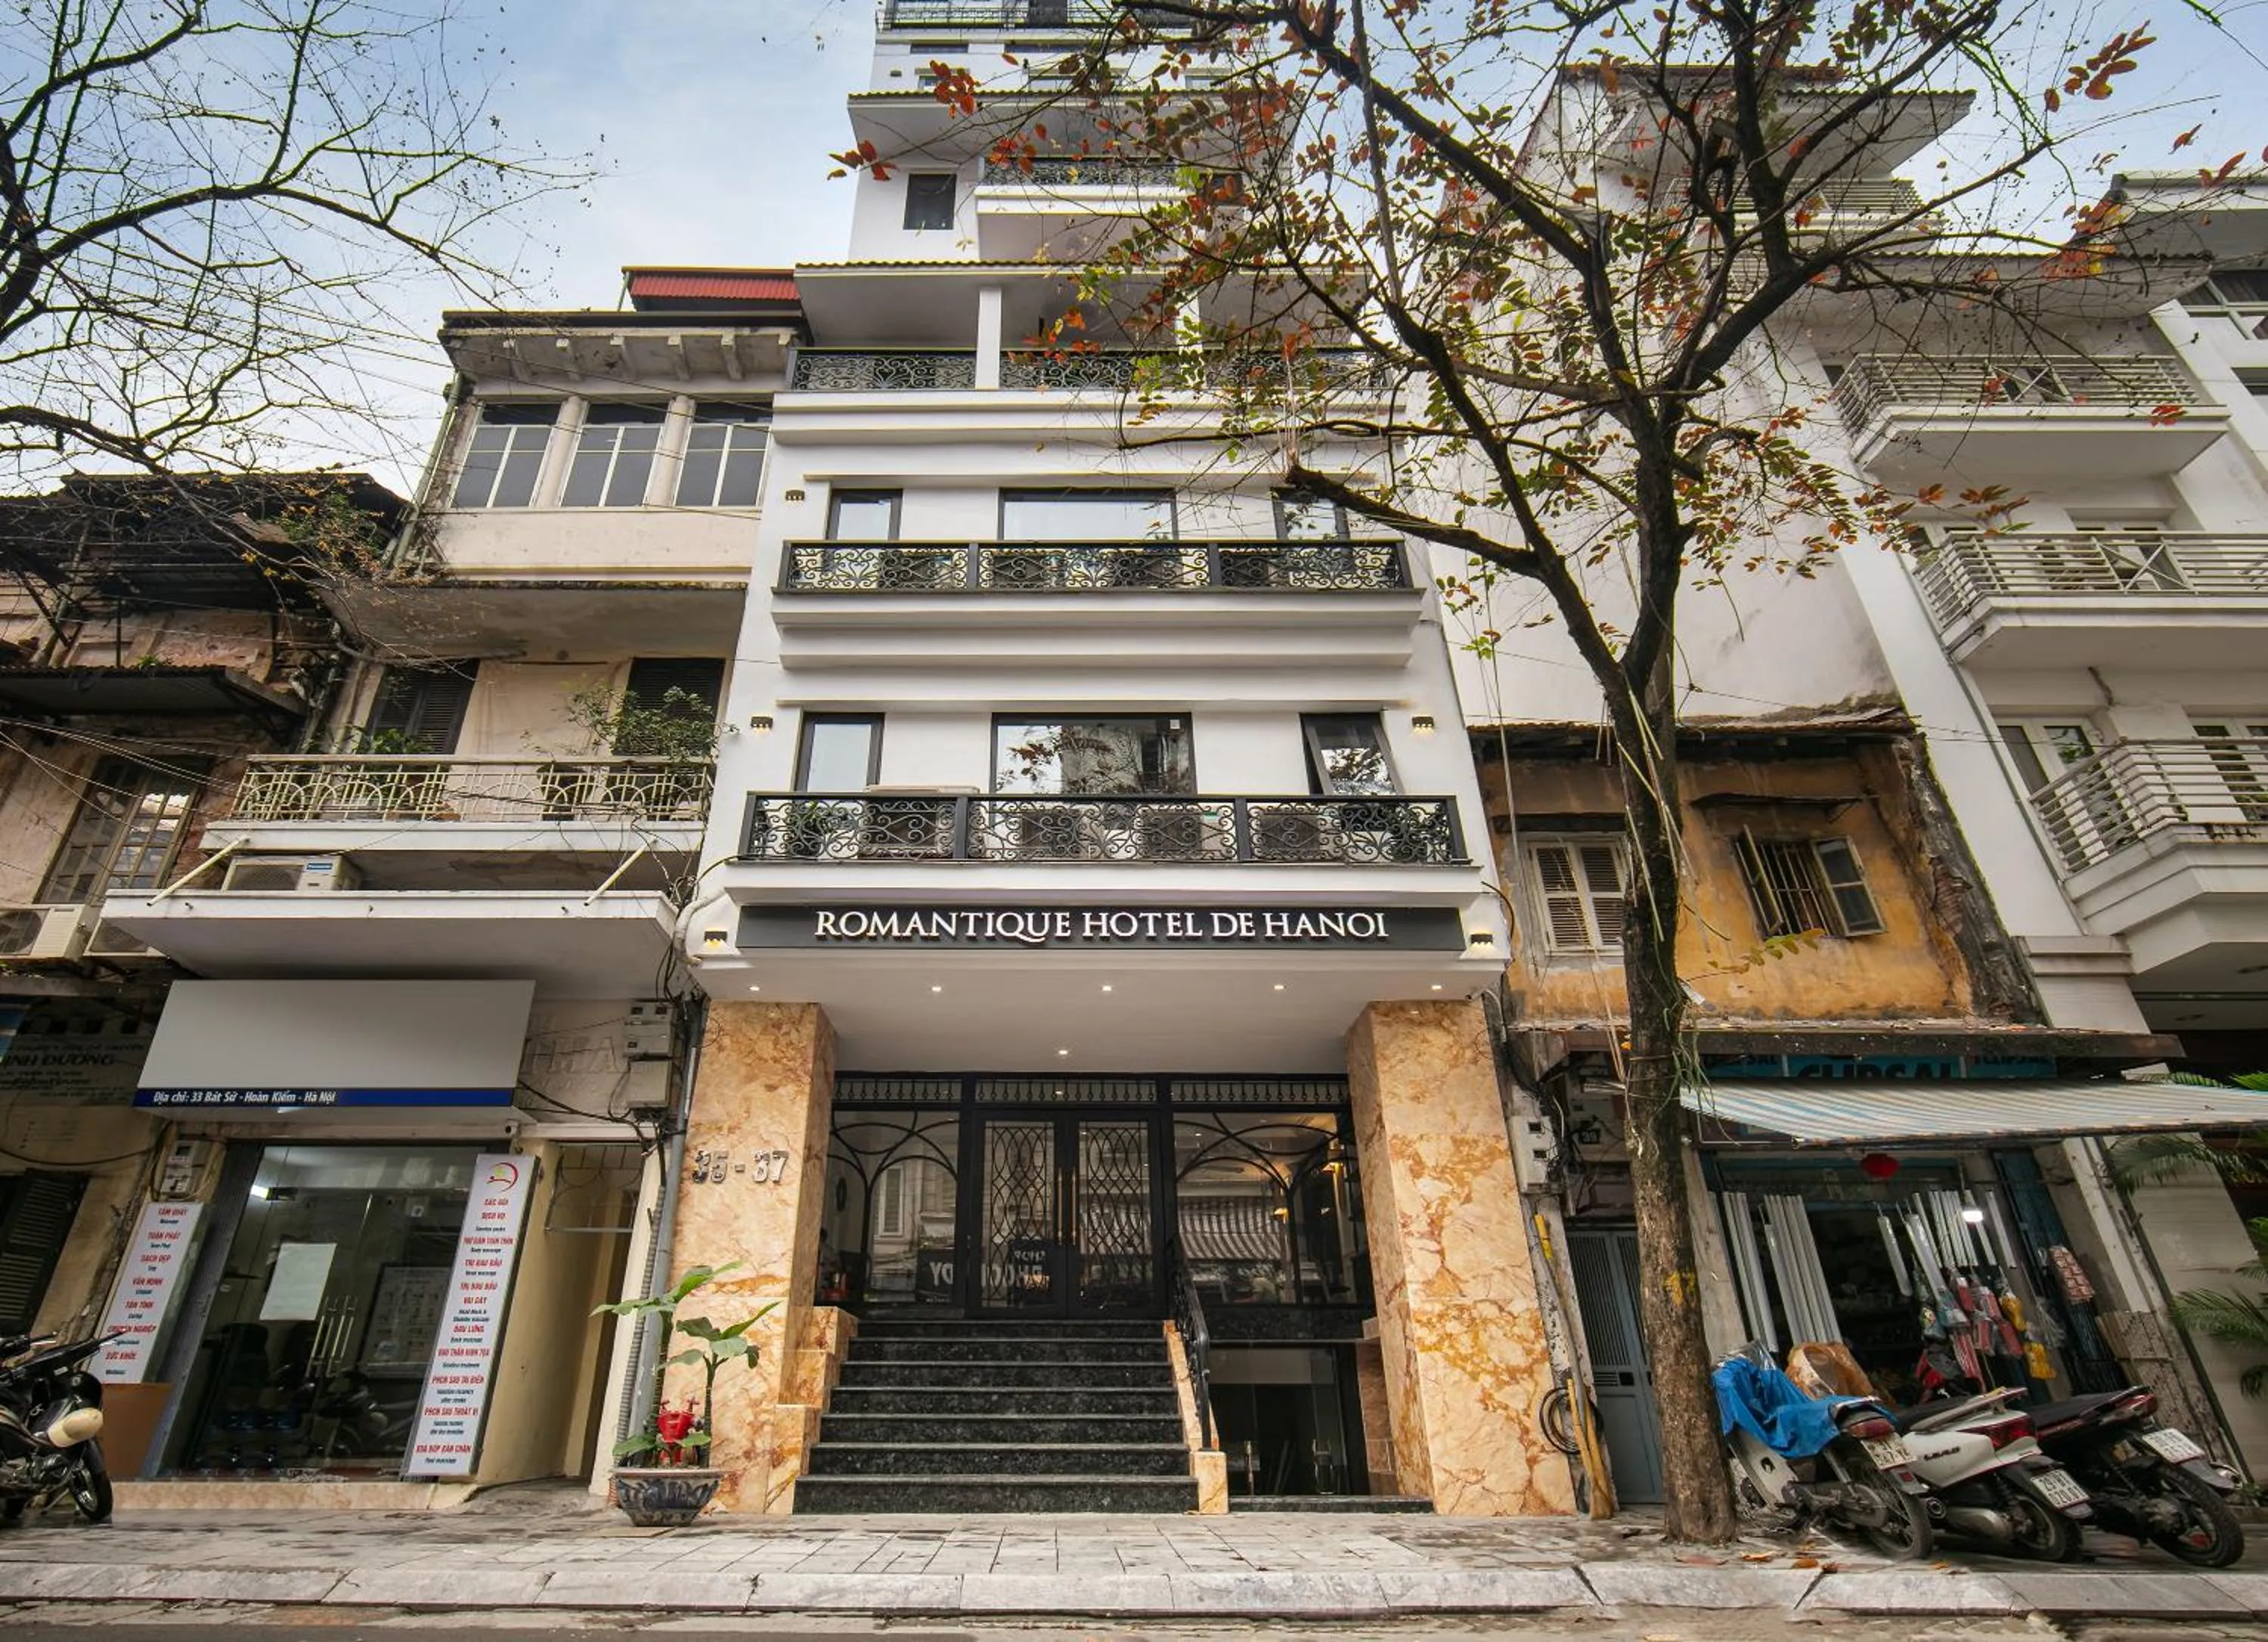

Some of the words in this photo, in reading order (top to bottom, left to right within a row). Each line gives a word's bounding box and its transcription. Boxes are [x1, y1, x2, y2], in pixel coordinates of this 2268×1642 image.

[814, 911, 1071, 945] ROMANTIQUE
[1083, 911, 1203, 940] HOTEL
[1211, 911, 1254, 940] DE
[1262, 911, 1390, 940] HANOI
[153, 1091, 169, 1105] Địa
[171, 1090, 189, 1102] chỉ:
[191, 1091, 202, 1102] 33
[204, 1090, 222, 1102] Bát
[224, 1090, 239, 1102] Sứ
[244, 1090, 268, 1102] Hoàn
[272, 1089, 296, 1102] Kiếm
[304, 1090, 318, 1102] Hà
[318, 1090, 336, 1105] Nội
[754, 1150, 789, 1184] 37
